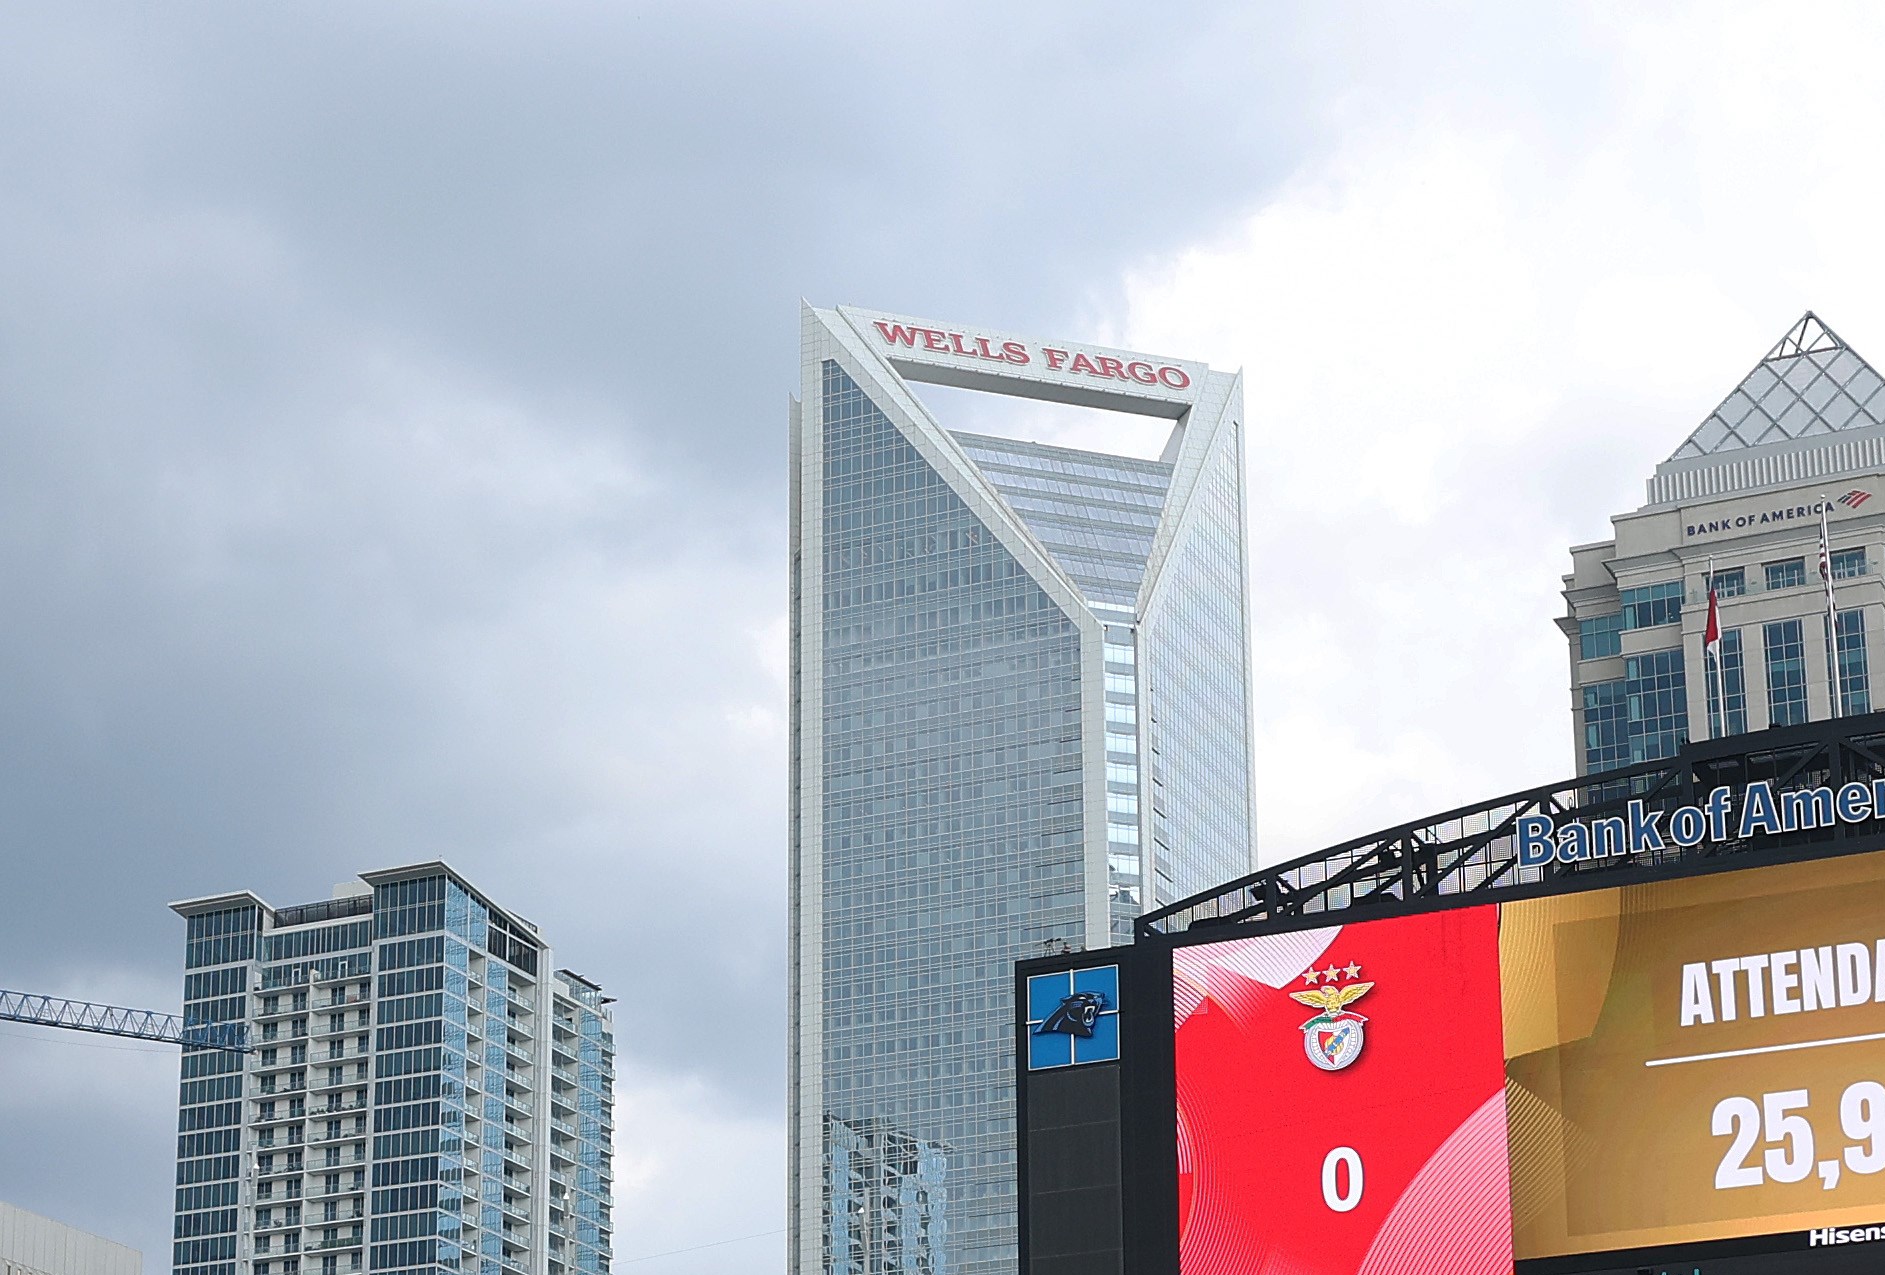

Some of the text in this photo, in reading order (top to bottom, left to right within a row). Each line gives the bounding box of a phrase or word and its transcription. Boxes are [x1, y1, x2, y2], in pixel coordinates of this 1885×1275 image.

[873, 319, 1191, 390] WELLS FARGO
[1687, 519, 1731, 537] BANK
[1735, 514, 1756, 528] OF
[1516, 804, 1666, 868] Bank
[1668, 783, 1735, 848] of
[1321, 1146, 1364, 1212] 0
